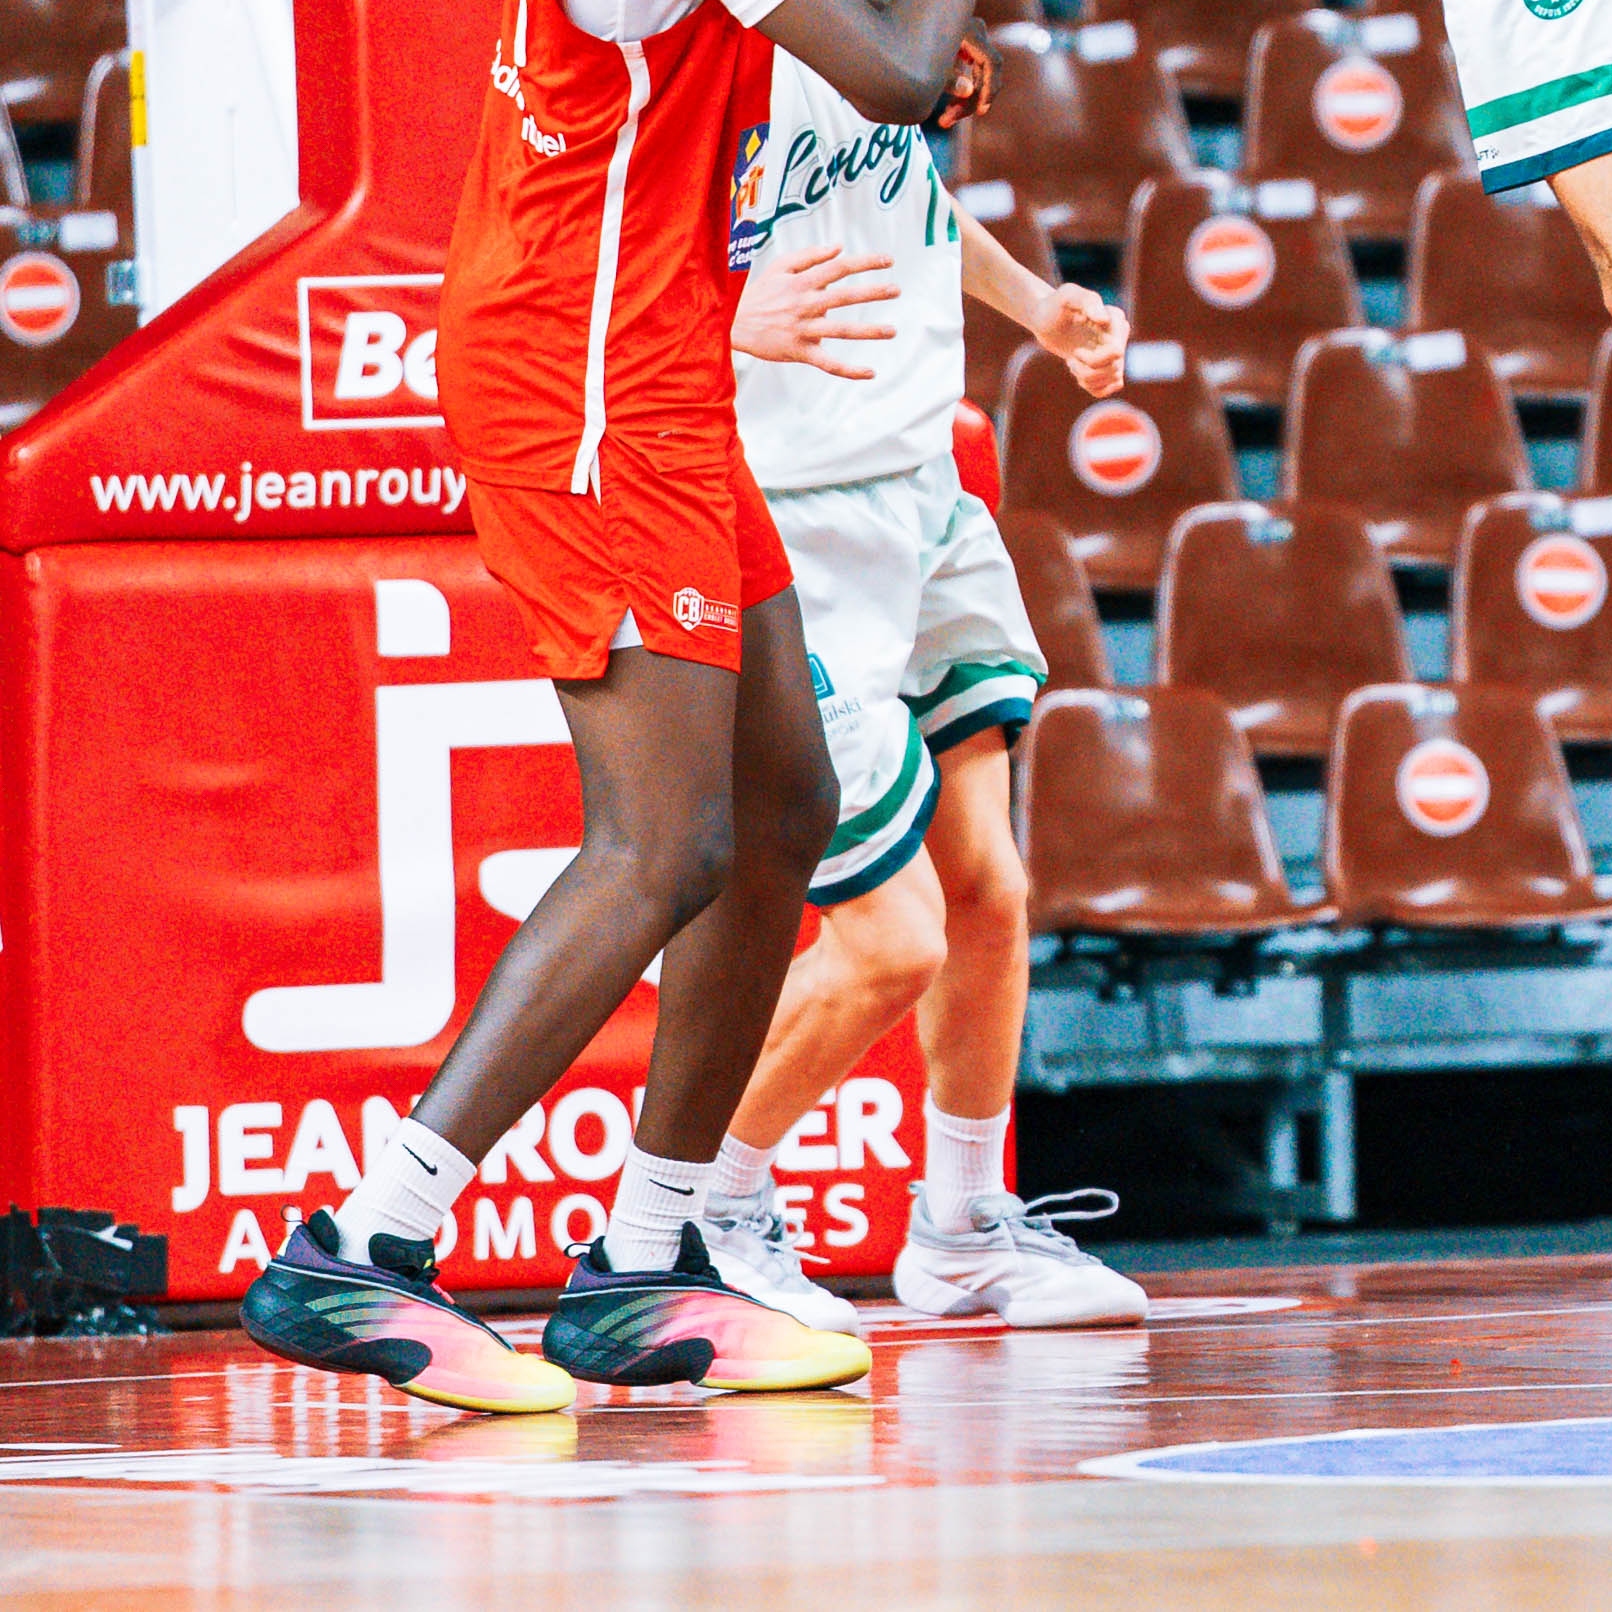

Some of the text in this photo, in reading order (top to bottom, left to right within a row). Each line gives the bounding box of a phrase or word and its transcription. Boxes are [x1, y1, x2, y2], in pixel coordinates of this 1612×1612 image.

[90, 460, 468, 522] www.jeanrouy
[677, 595, 701, 622] CB
[480, 1076, 912, 1185] ROER
